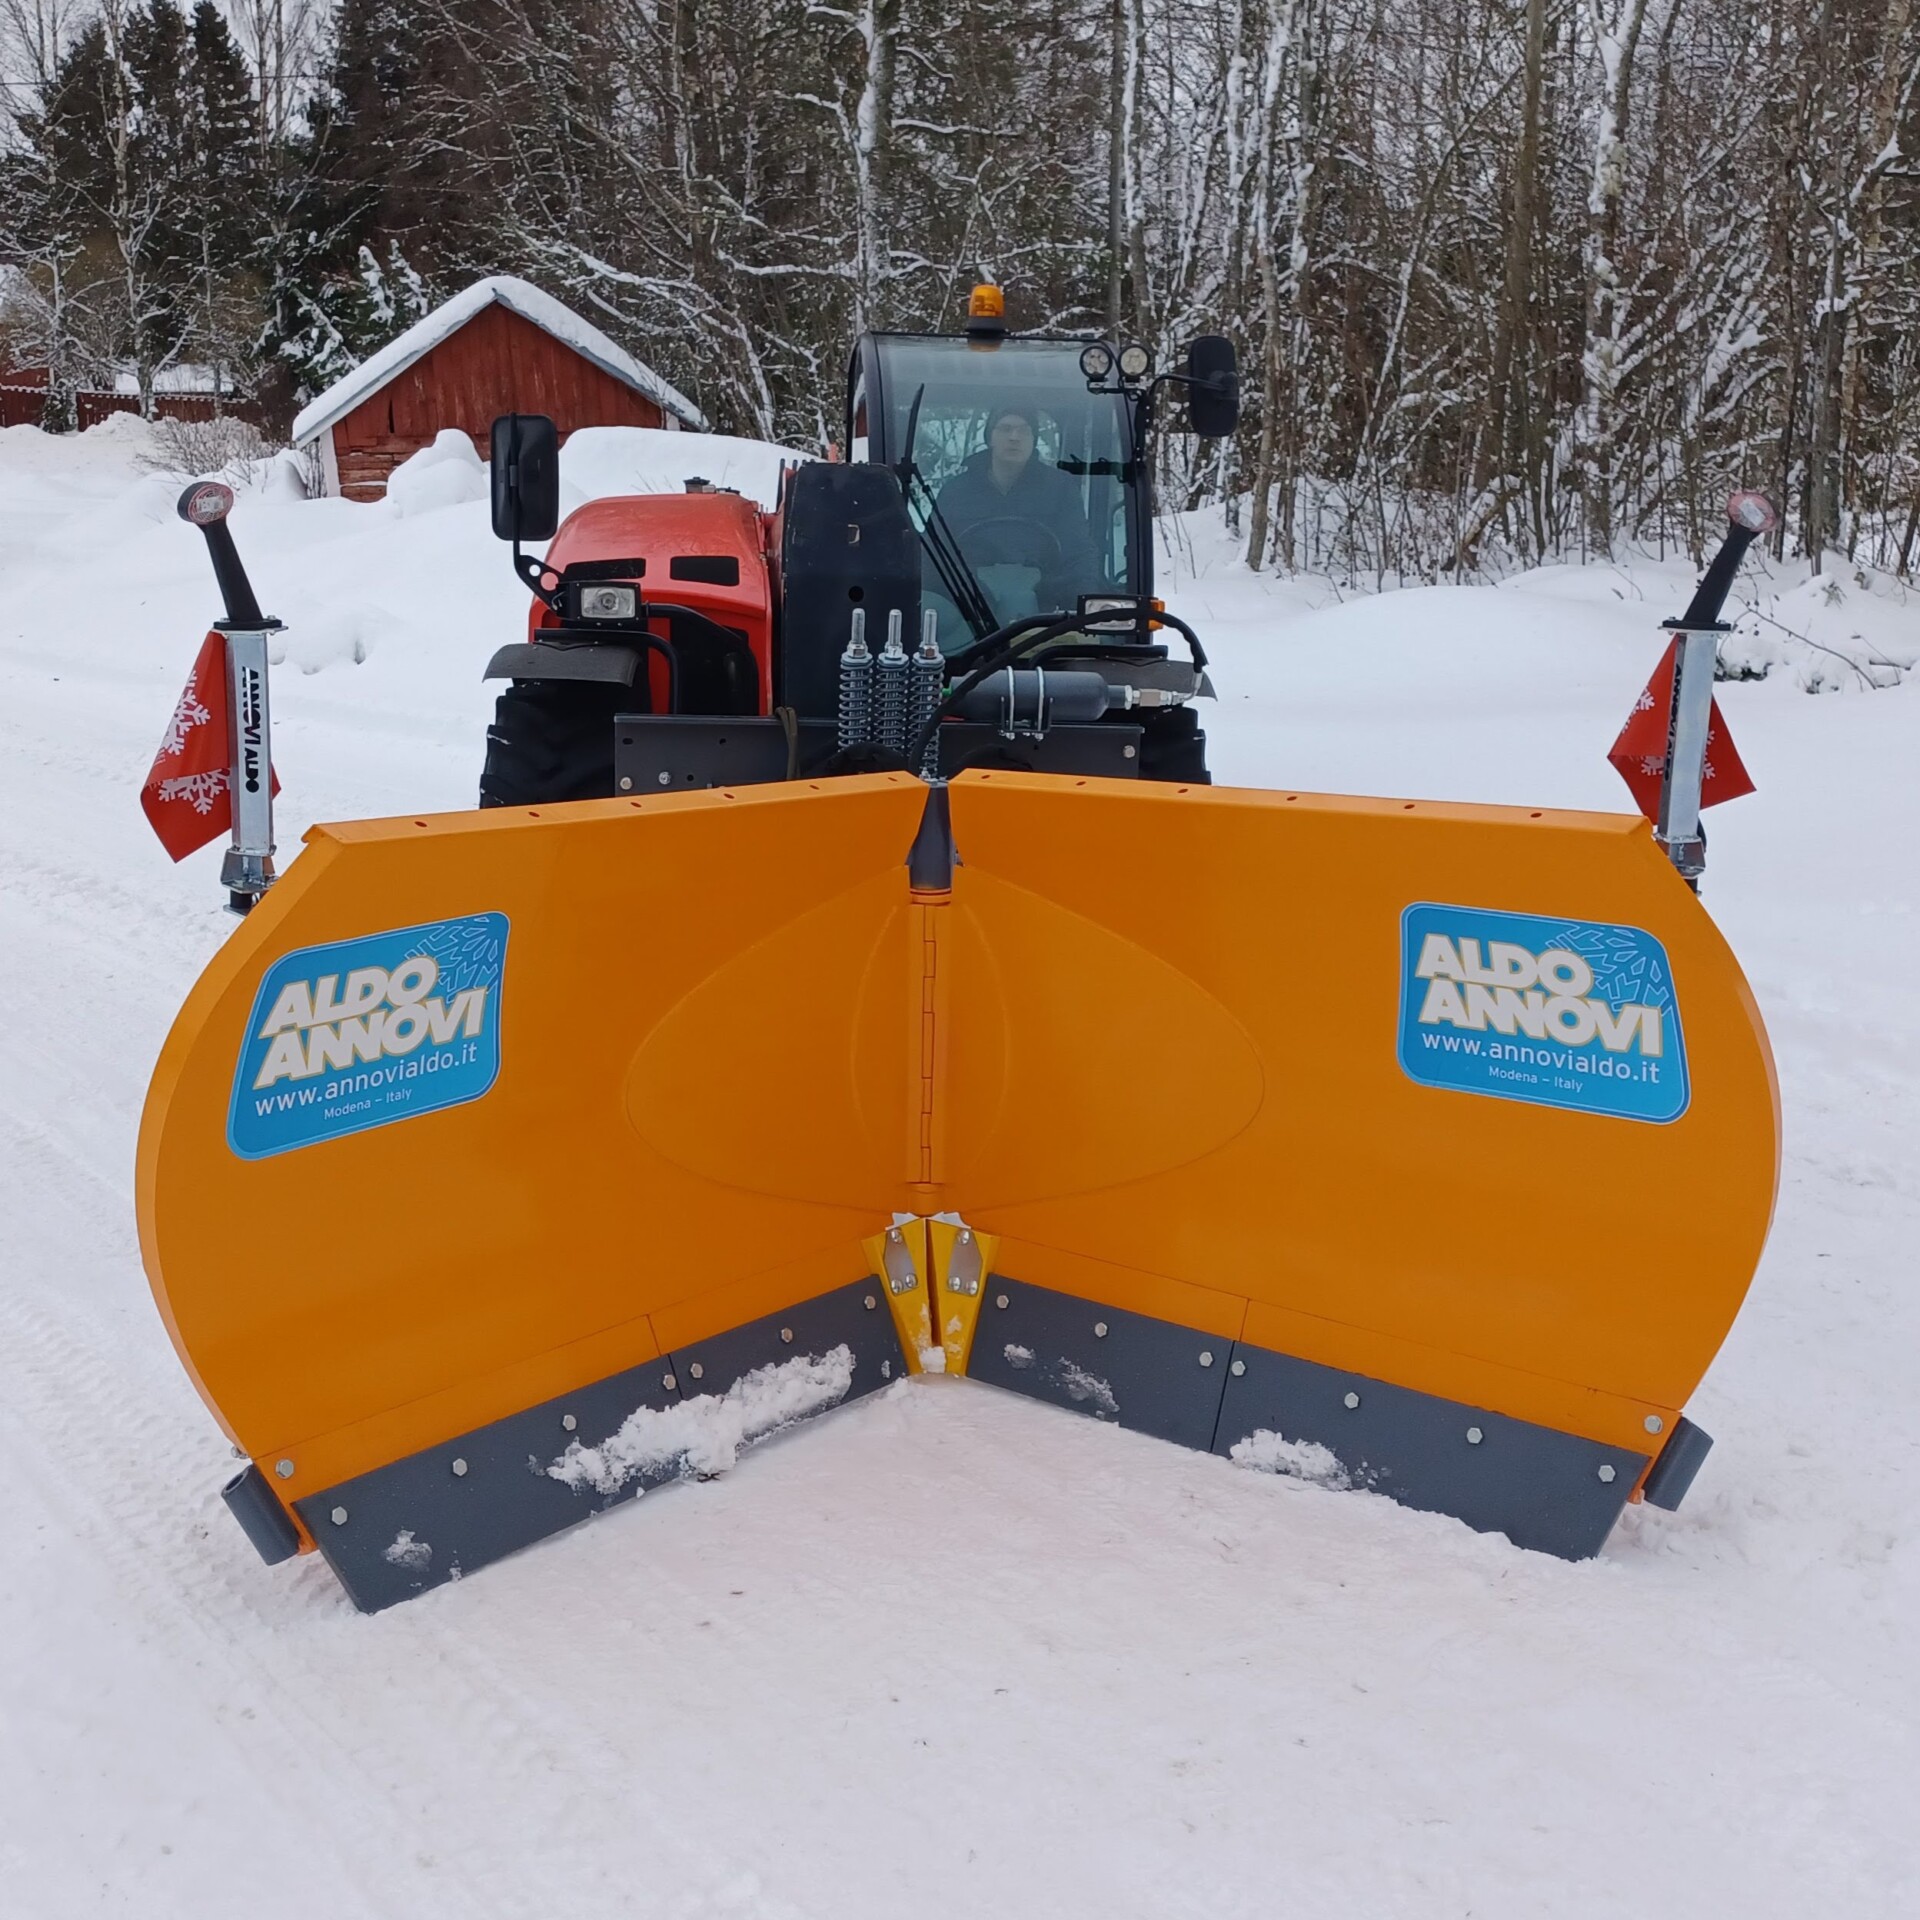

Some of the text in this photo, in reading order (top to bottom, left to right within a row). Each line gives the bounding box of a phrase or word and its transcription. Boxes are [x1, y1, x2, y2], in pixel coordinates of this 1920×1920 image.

[242, 666, 261, 793] ANNOVI ALDO
[258, 955, 439, 1039] ALDO
[1415, 933, 1594, 999] ALDO
[252, 987, 487, 1090] ANNOVI
[1418, 978, 1664, 1057] ANNOVI
[255, 1042, 477, 1117] www.annovialdo.it
[1422, 1032, 1660, 1084] www.annovialdo.it
[1488, 1066, 1538, 1084] Modena
[1554, 1076, 1584, 1093] Italy
[323, 1099, 371, 1120] Modena
[386, 1088, 412, 1102] Italy
